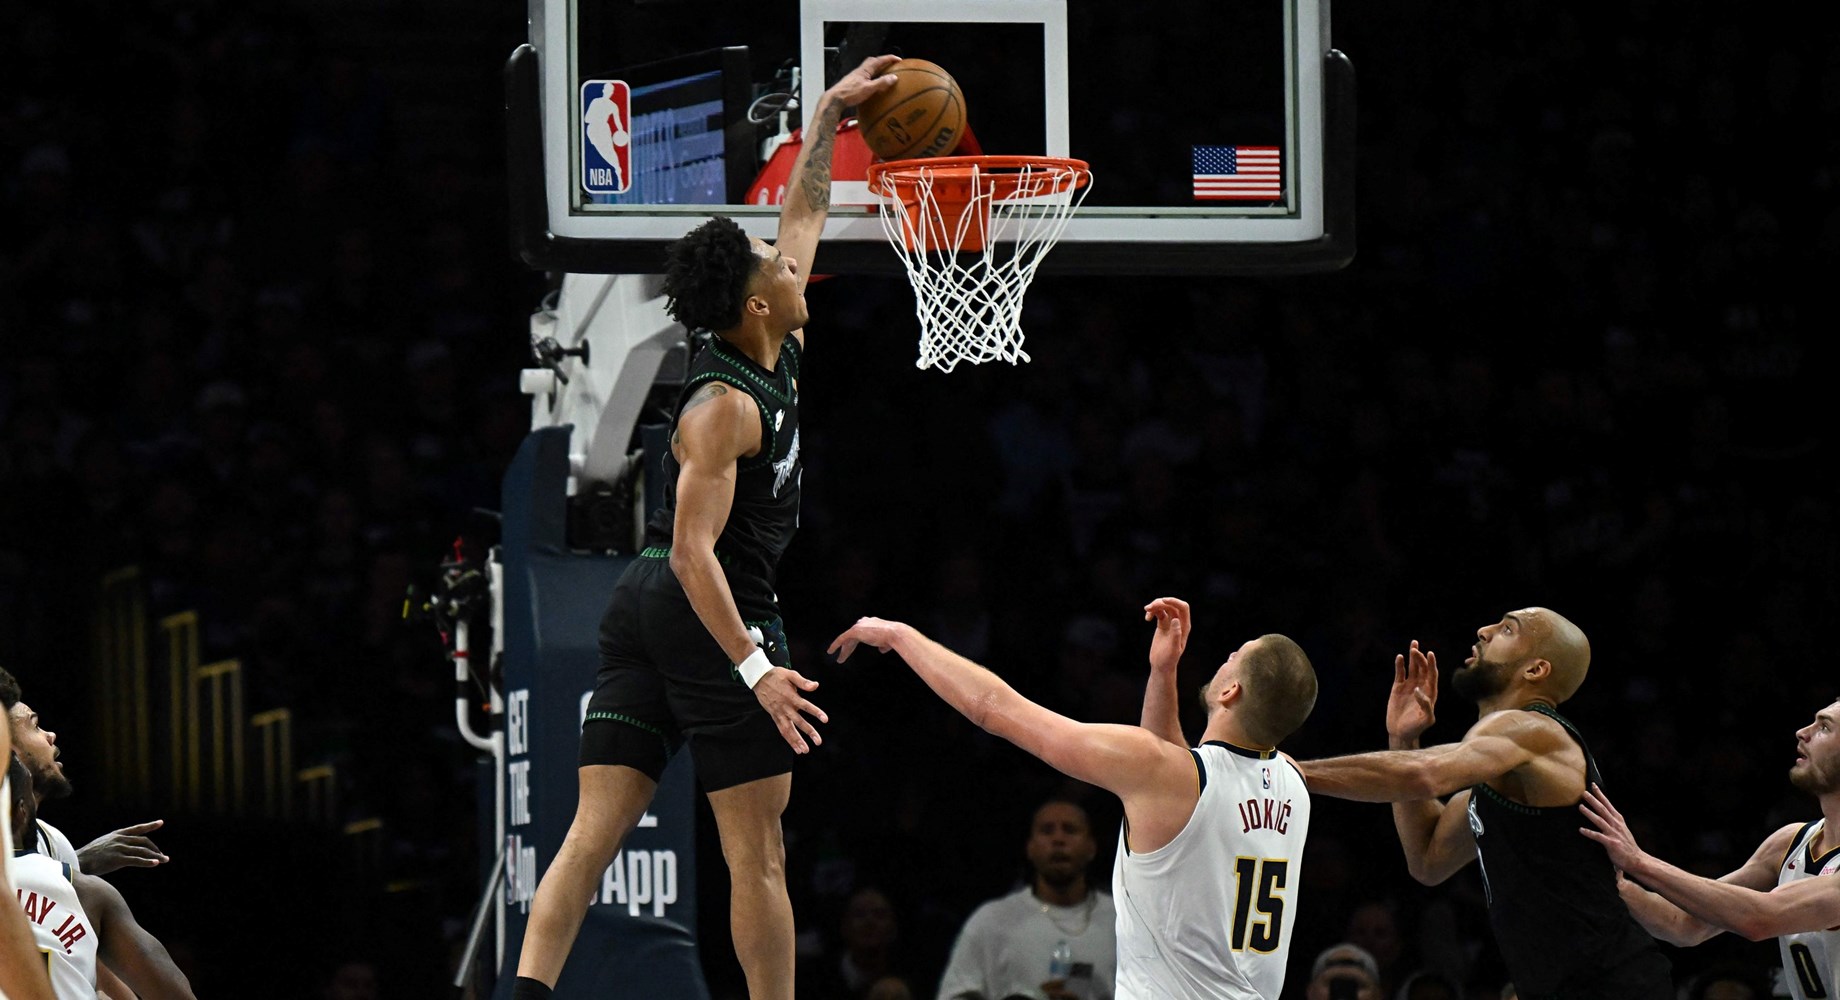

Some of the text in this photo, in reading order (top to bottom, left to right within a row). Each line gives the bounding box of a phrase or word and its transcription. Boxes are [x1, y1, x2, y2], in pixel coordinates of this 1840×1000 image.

[589, 168, 613, 186] NBA
[508, 688, 529, 756] GET
[509, 760, 531, 826] THE
[1238, 798, 1292, 836] JOKIĆ
[601, 847, 678, 917] App
[1230, 855, 1289, 955] 15
[16, 888, 87, 955] AY JR.
